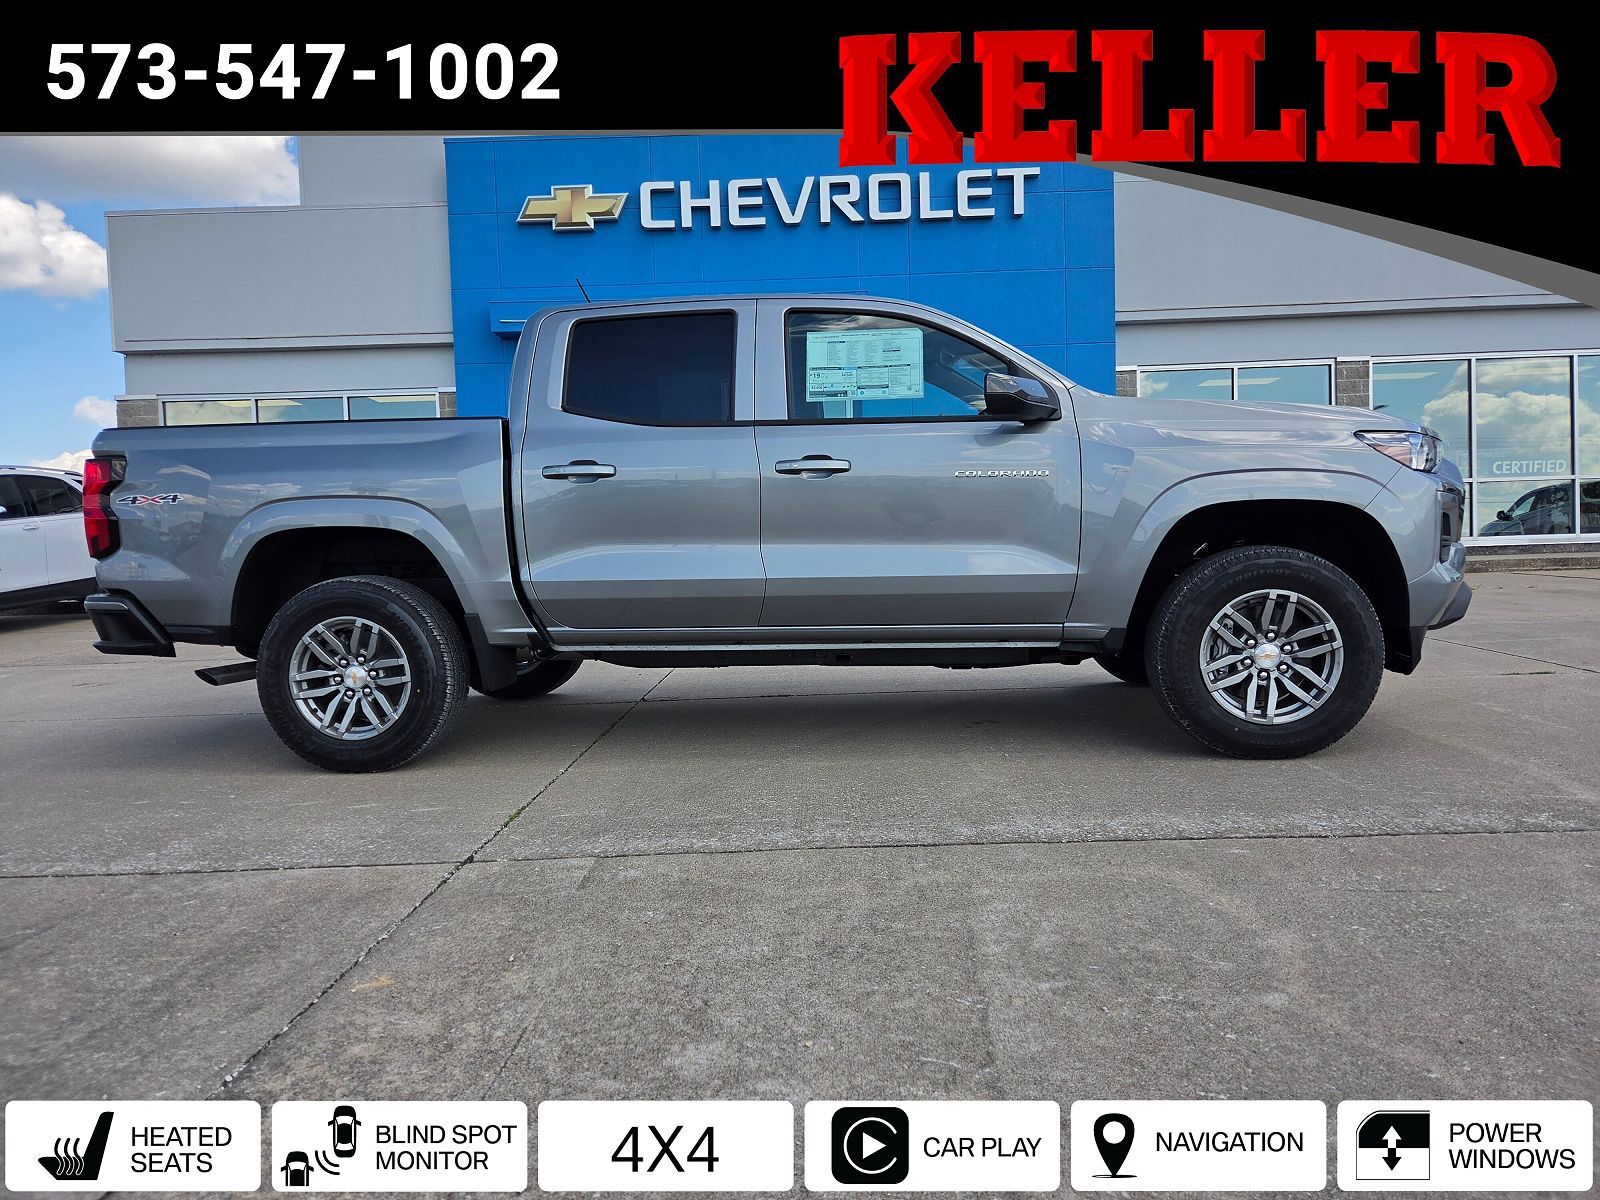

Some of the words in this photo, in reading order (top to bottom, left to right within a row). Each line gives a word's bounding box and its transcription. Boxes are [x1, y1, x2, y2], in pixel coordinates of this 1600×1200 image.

[640, 167, 1041, 230] CHEVROLET
[953, 469, 1050, 478] COLORADO
[1492, 459, 1567, 475] CERTIFIED
